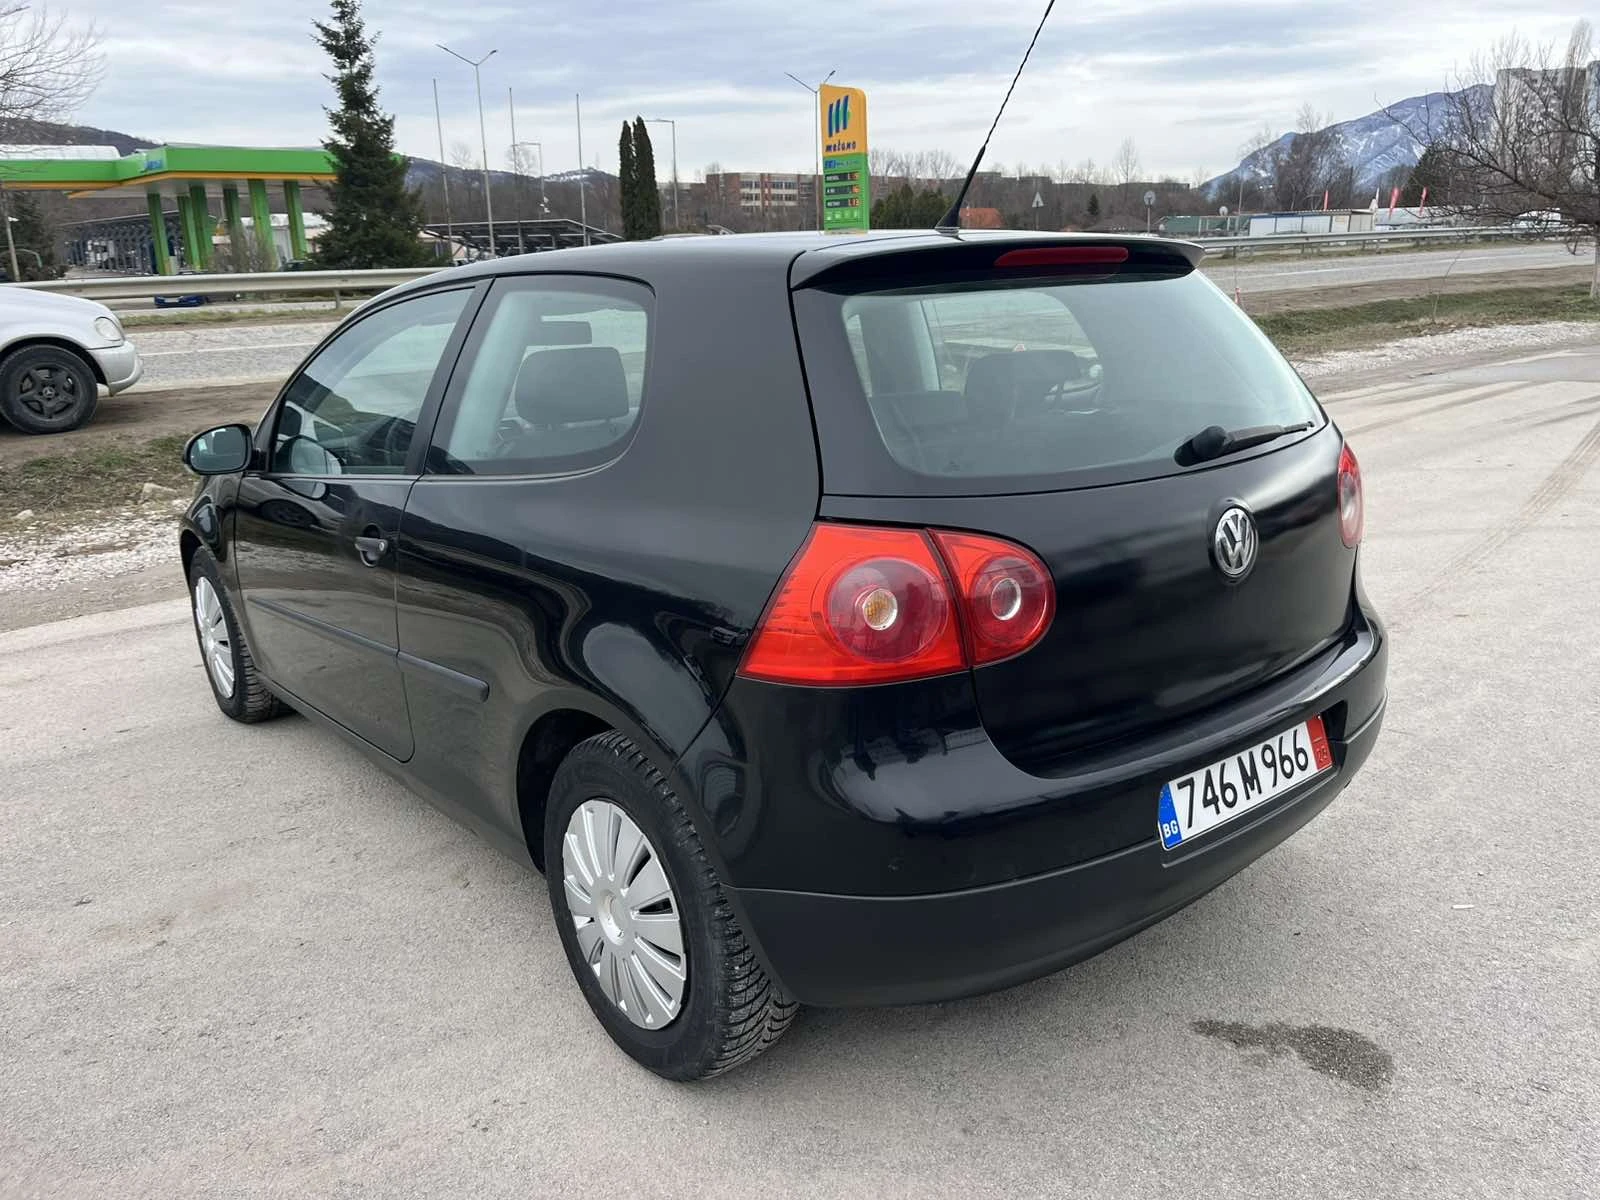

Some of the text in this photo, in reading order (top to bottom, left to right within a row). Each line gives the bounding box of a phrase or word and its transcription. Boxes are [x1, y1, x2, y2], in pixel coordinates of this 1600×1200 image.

[1176, 729, 1309, 830] 746 M 966
[1162, 820, 1179, 838] BG
